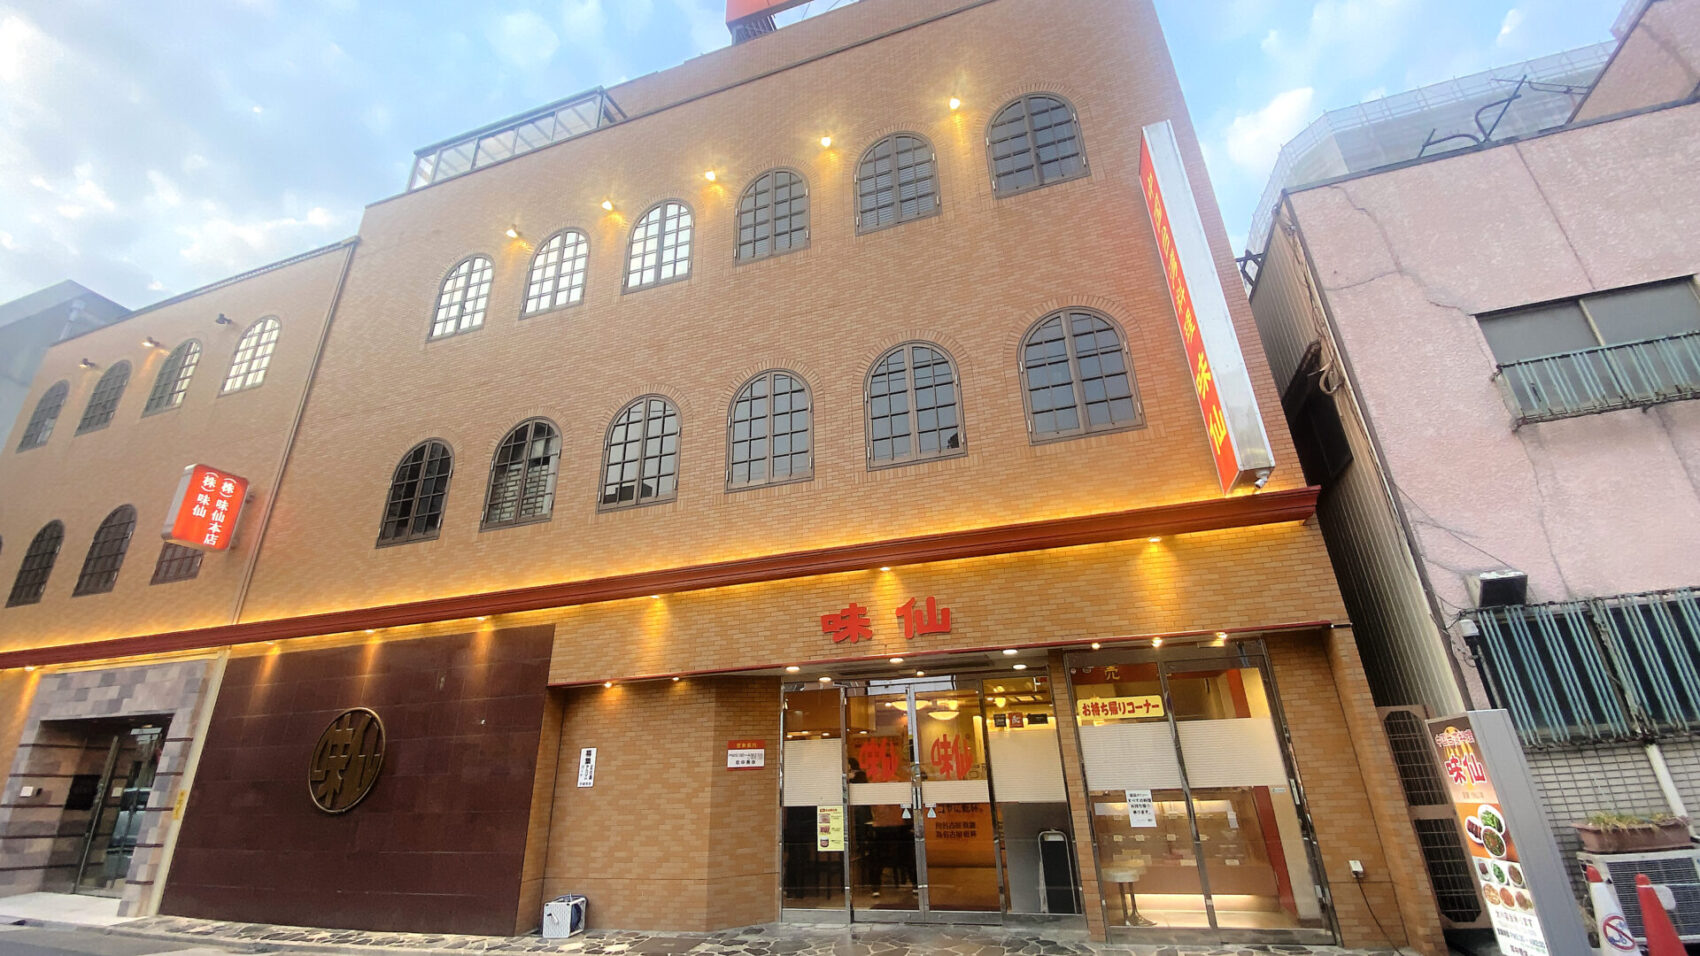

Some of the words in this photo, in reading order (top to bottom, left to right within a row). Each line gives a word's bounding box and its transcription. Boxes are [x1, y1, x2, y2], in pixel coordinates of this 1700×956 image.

[1196, 353, 1227, 455] 味仙
[820, 596, 952, 643] 味仙
[1082, 699, 1160, 716] お持ち帰りコーナー
[311, 713, 381, 808] 味仙
[931, 734, 974, 780] 味仙
[1445, 753, 1486, 784] 味仙
